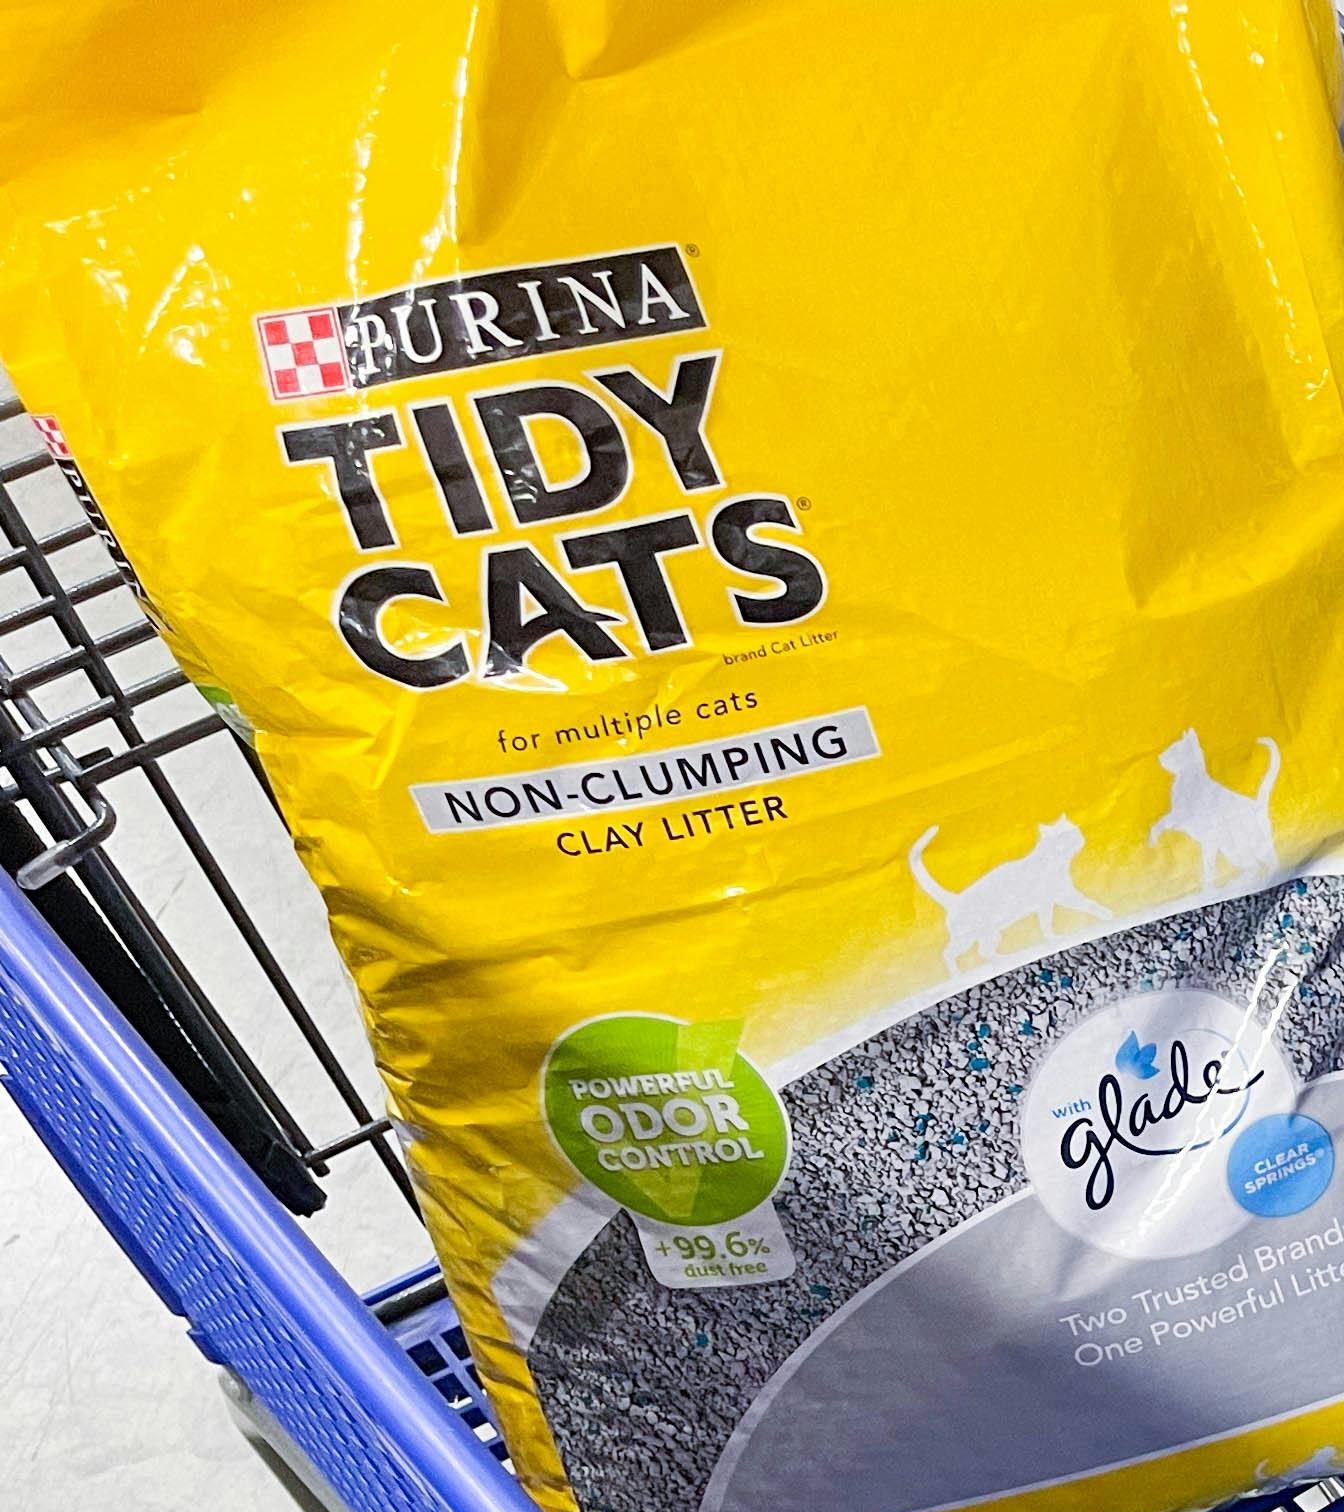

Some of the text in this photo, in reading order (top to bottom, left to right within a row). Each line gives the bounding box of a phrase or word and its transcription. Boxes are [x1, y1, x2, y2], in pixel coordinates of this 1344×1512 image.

[353, 261, 692, 377] PURINA
[280, 353, 723, 550] TIDY
[337, 497, 825, 689] CATS
[722, 629, 840, 667] brand Cat Litter
[497, 688, 759, 754] for multiple cats
[444, 723, 849, 826] NON-CLUMPING
[556, 794, 789, 859] CLAY LITTER
[567, 1068, 735, 1101] POWERFUL
[1051, 1098, 1093, 1120] with
[579, 1093, 750, 1144] ODOR
[1060, 1040, 1265, 1211] glade
[597, 1136, 765, 1172] CONTROL
[1253, 1142, 1310, 1176] CLEAR
[655, 1231, 771, 1262] +99.6%
[684, 1260, 769, 1279] dust free
[1059, 1306, 1128, 1338] Two
[1130, 1254, 1249, 1316] Trusted
[1073, 1335, 1144, 1367] One
[1149, 1278, 1286, 1347] Powerful
